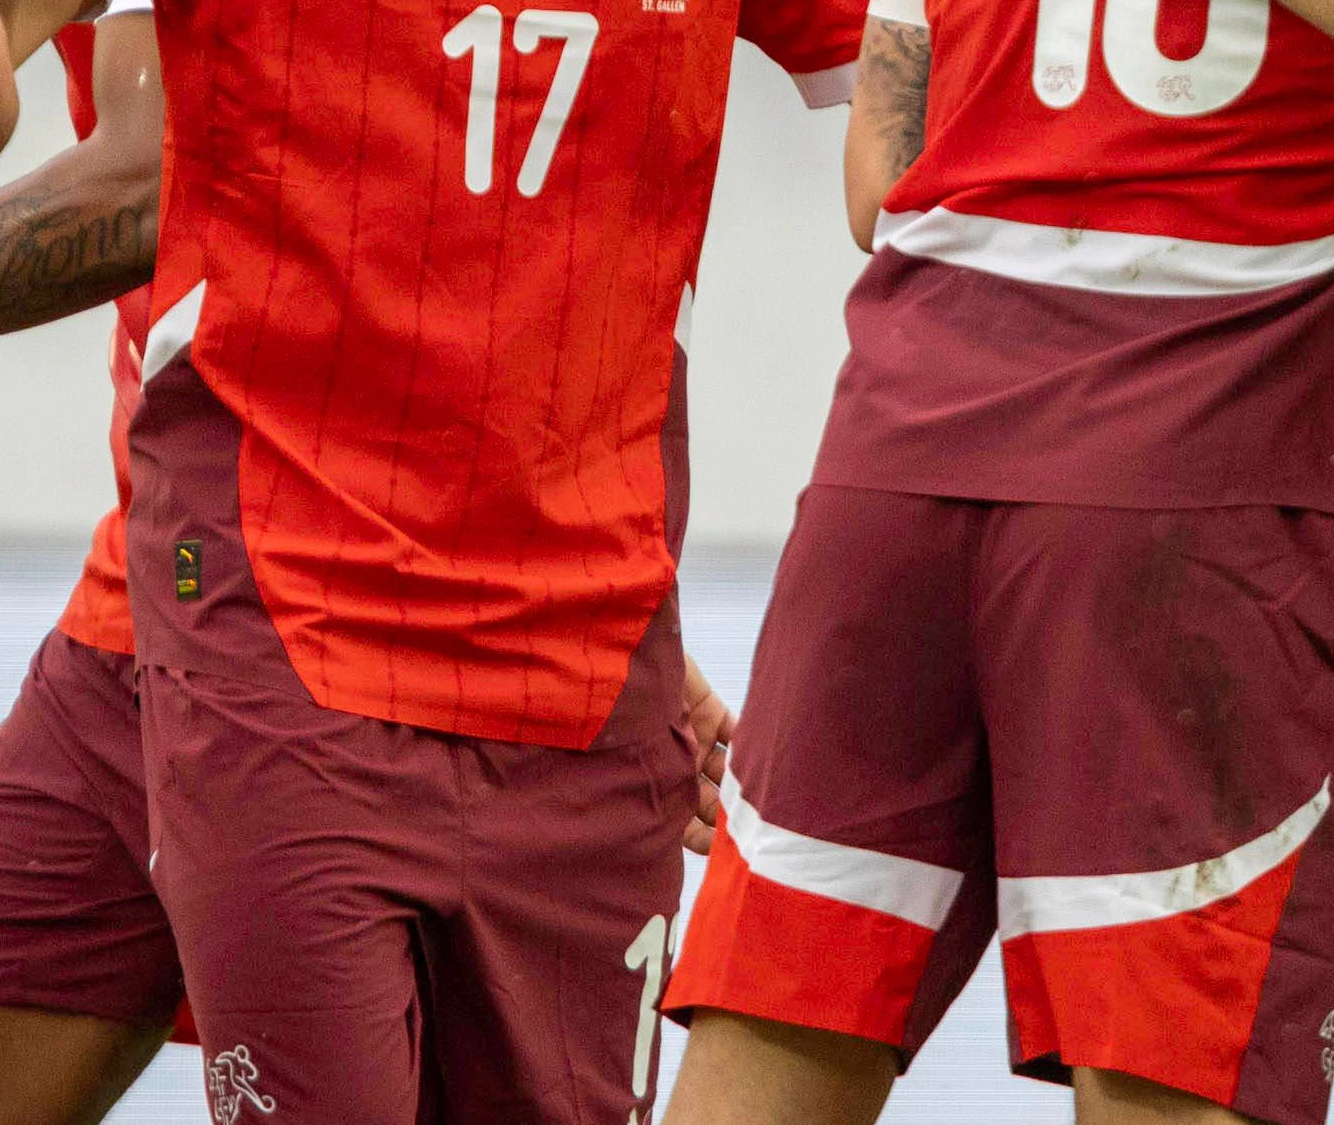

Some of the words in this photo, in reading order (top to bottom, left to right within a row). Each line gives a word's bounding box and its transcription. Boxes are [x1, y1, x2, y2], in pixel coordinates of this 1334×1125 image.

[656, 0, 685, 13] GALLEN
[442, 4, 599, 198] 17
[625, 913, 680, 1099] 1
